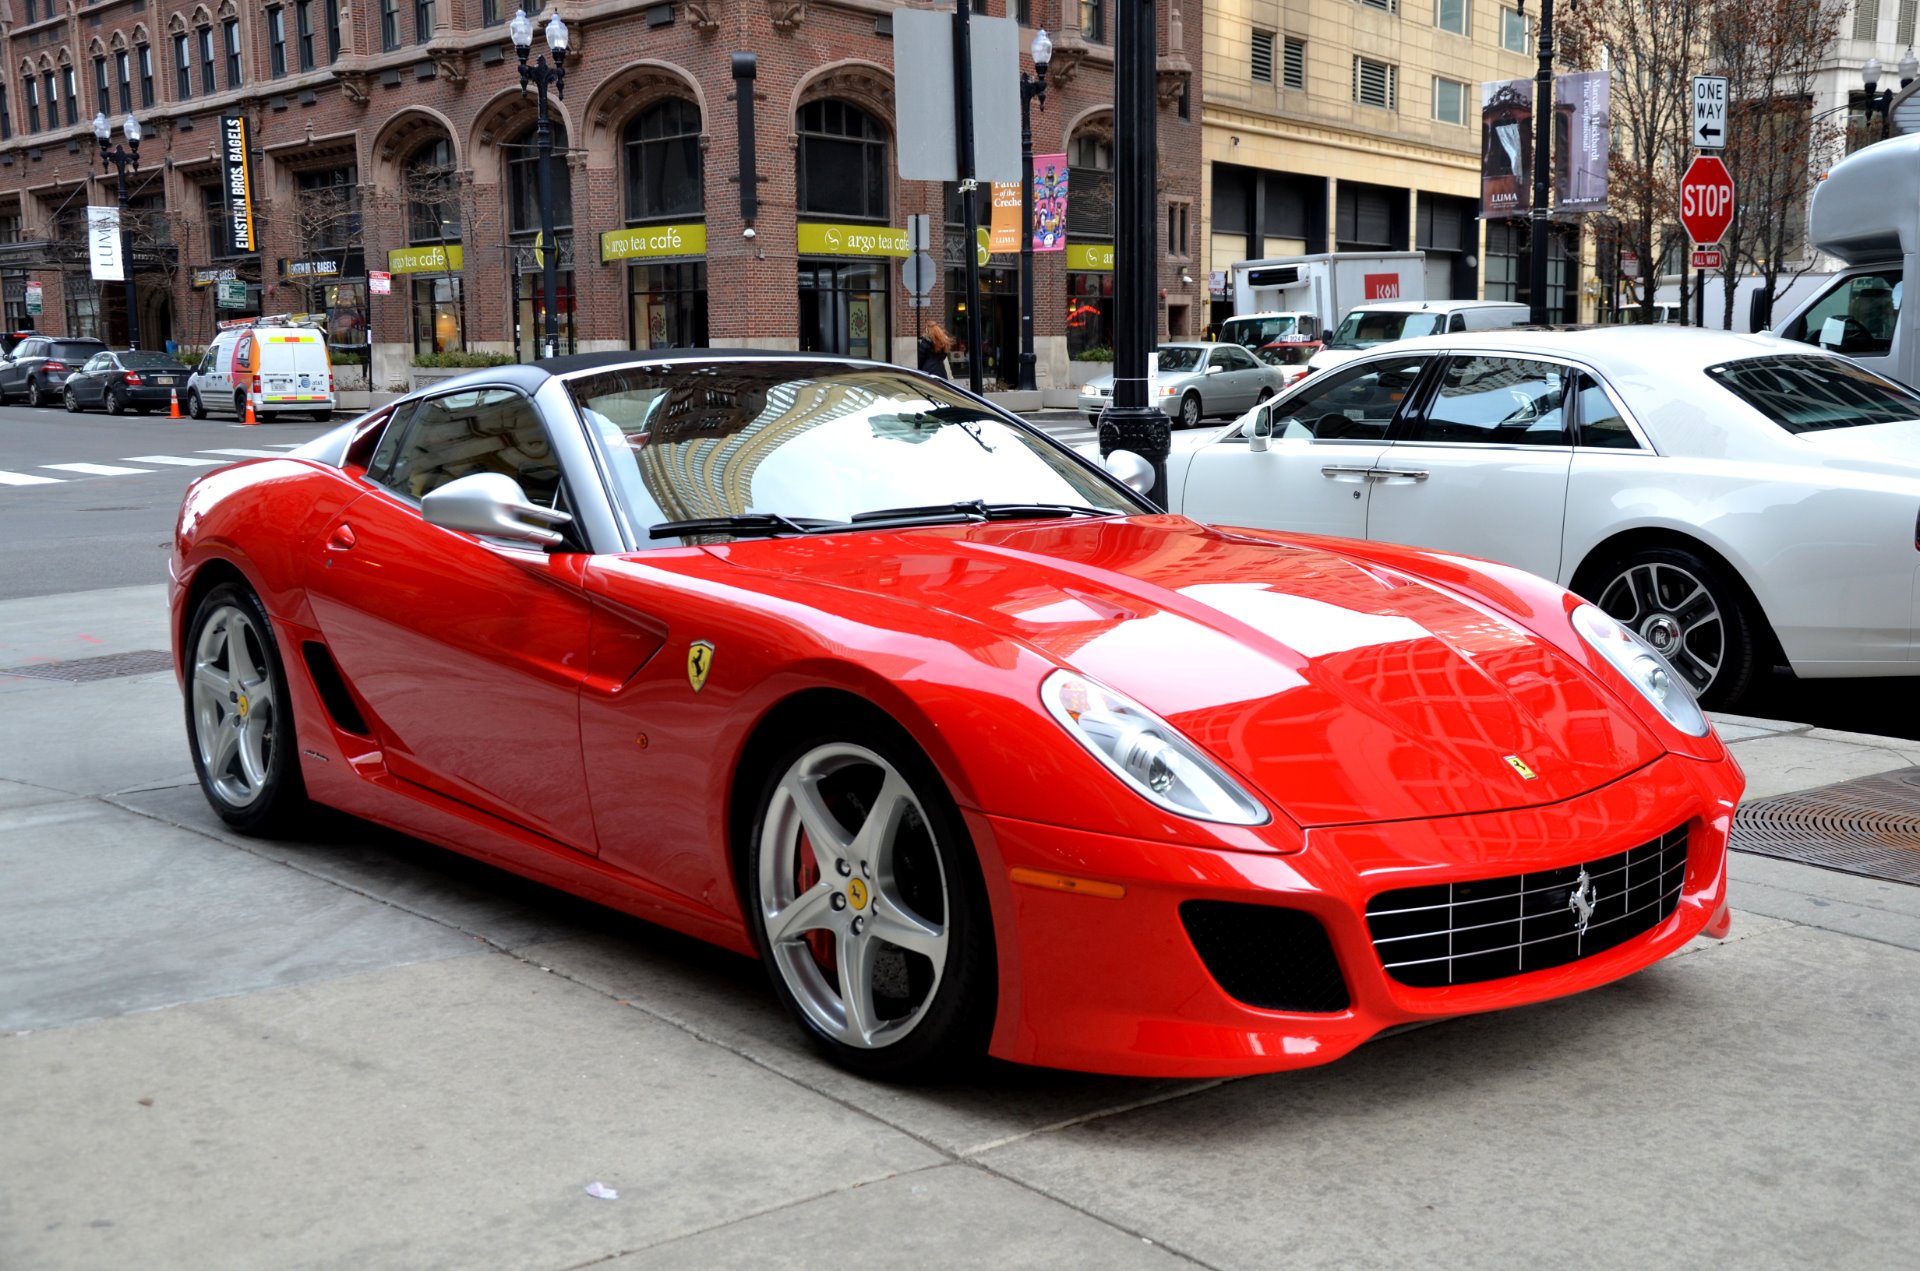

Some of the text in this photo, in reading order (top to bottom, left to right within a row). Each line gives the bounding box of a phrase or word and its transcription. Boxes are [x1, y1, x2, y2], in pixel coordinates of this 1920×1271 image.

[1583, 80, 1592, 98] True
[1697, 83, 1723, 100] ONE
[1697, 103, 1723, 119] WAY
[1591, 79, 1601, 161] Marcella Hackbardt
[226, 119, 250, 249] EINSTEIN BROS. BAGELS
[999, 189, 1016, 198] of the
[1491, 193, 1518, 202] LUMA
[1683, 184, 1731, 217] STOP
[994, 198, 1022, 208] Creche
[612, 227, 682, 257] argo tea café
[847, 235, 876, 253] argo
[878, 234, 892, 249] tea
[405, 255, 417, 267] tea
[420, 247, 444, 267] café
[1103, 253, 1114, 264] ar
[1694, 254, 1719, 265] ALL WAY
[317, 260, 337, 273] BAGELS
[1376, 283, 1398, 300] ICON
